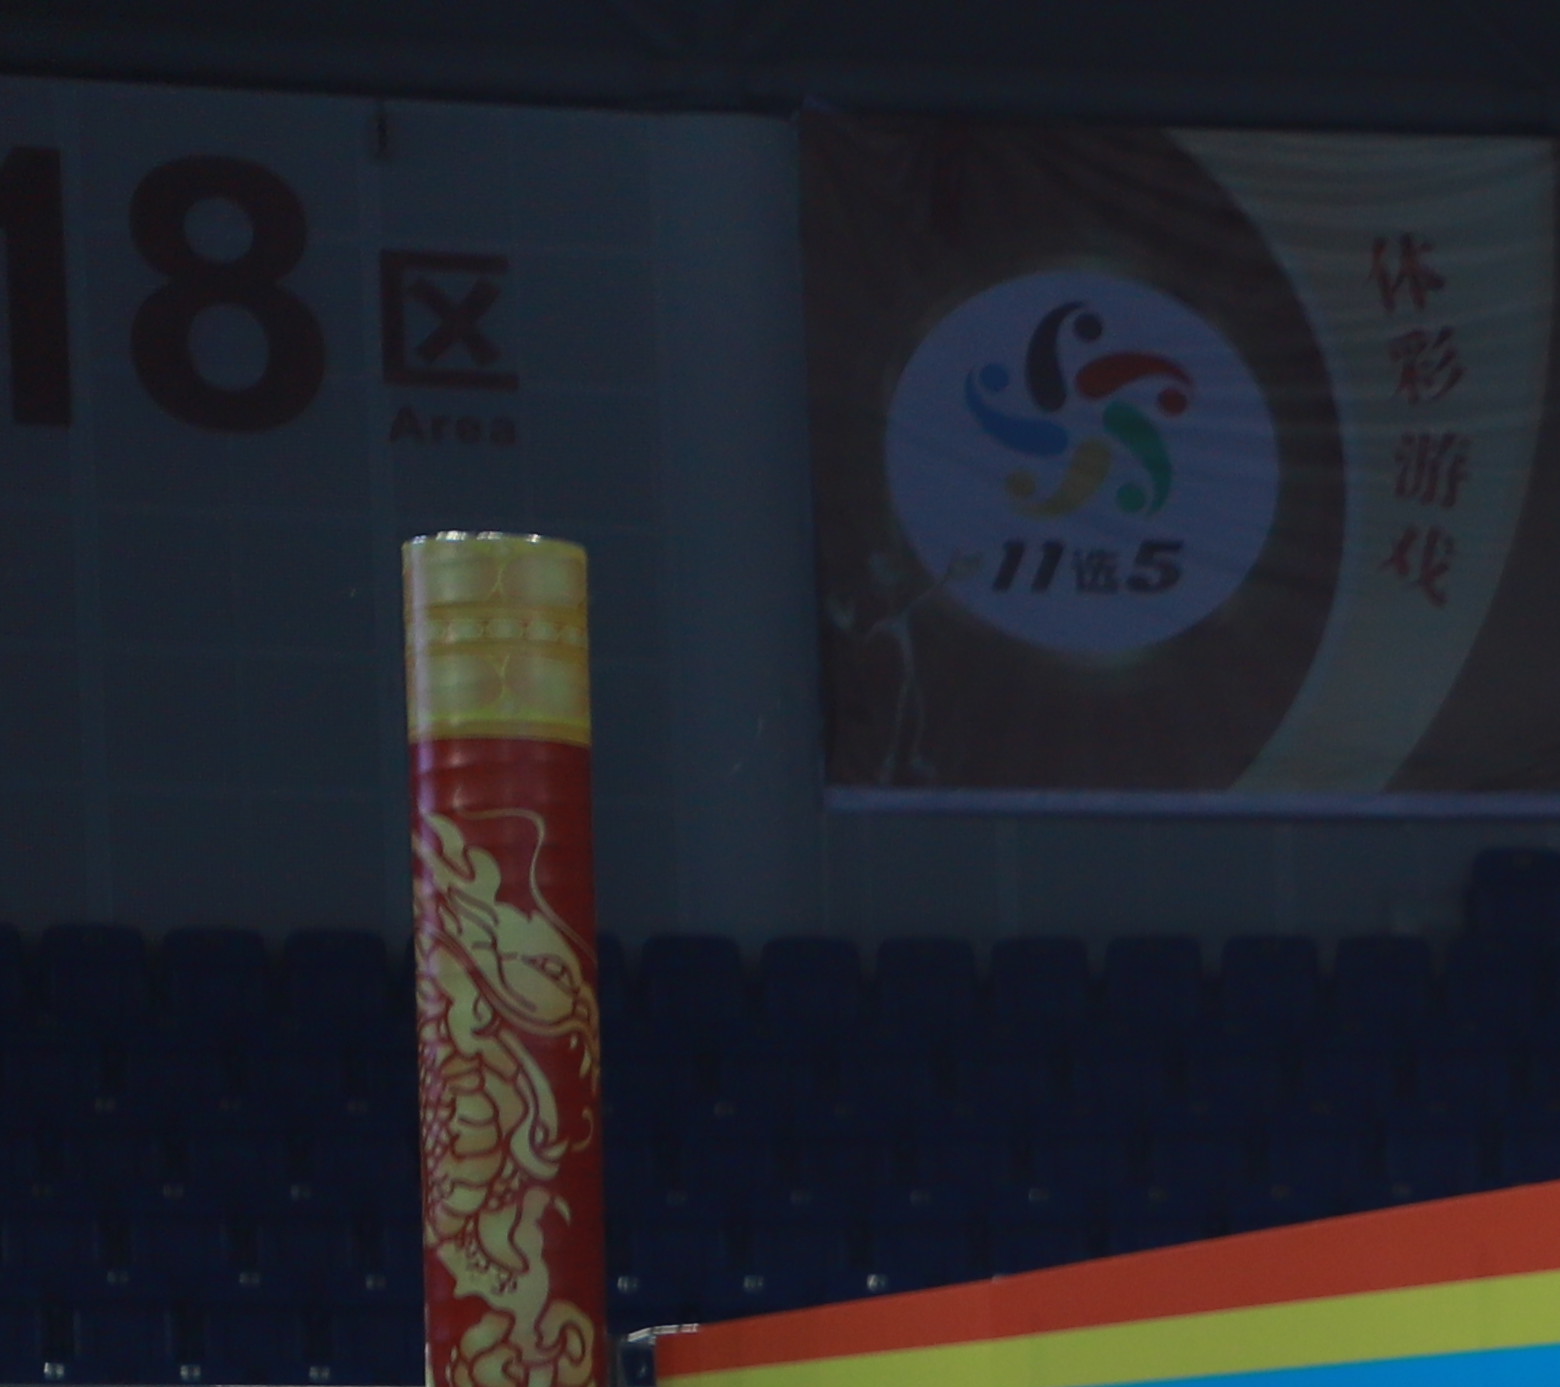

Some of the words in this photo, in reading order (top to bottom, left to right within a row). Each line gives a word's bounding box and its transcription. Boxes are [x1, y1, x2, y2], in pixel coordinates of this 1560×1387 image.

[0, 147, 326, 433] 18
[379, 248, 520, 391] 区
[390, 404, 518, 446] Area
